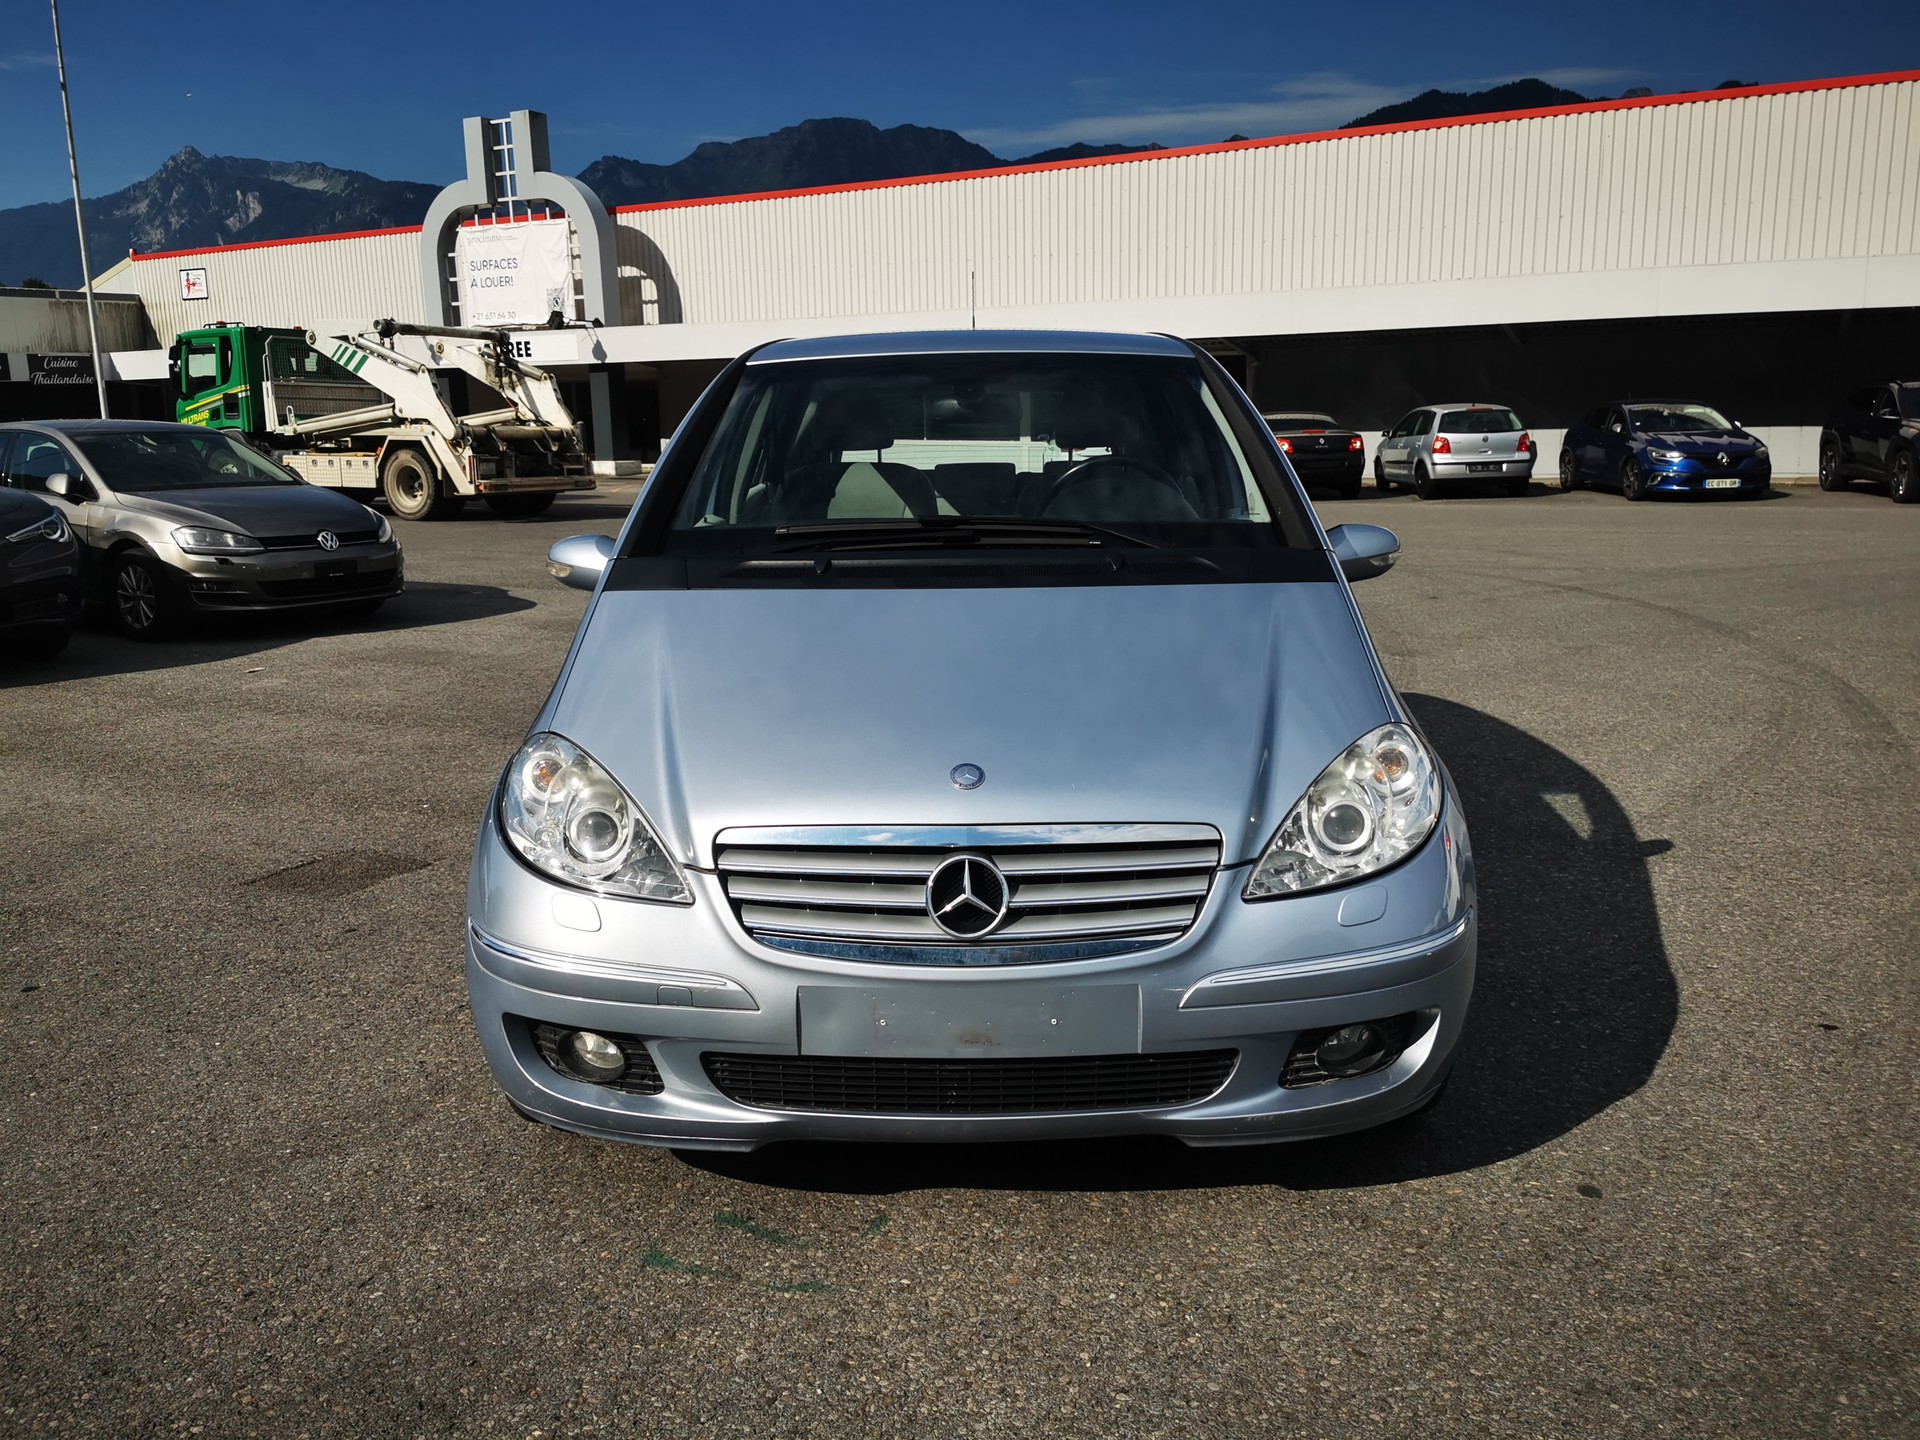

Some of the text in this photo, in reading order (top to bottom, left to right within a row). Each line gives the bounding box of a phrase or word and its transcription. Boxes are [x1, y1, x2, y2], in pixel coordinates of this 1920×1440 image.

[470, 257, 518, 271] SURFACES
[470, 275, 514, 288] À LOUER!
[507, 311, 516, 319] 30
[44, 356, 79, 369] Cuisine
[31, 371, 95, 384] Thailandaise
